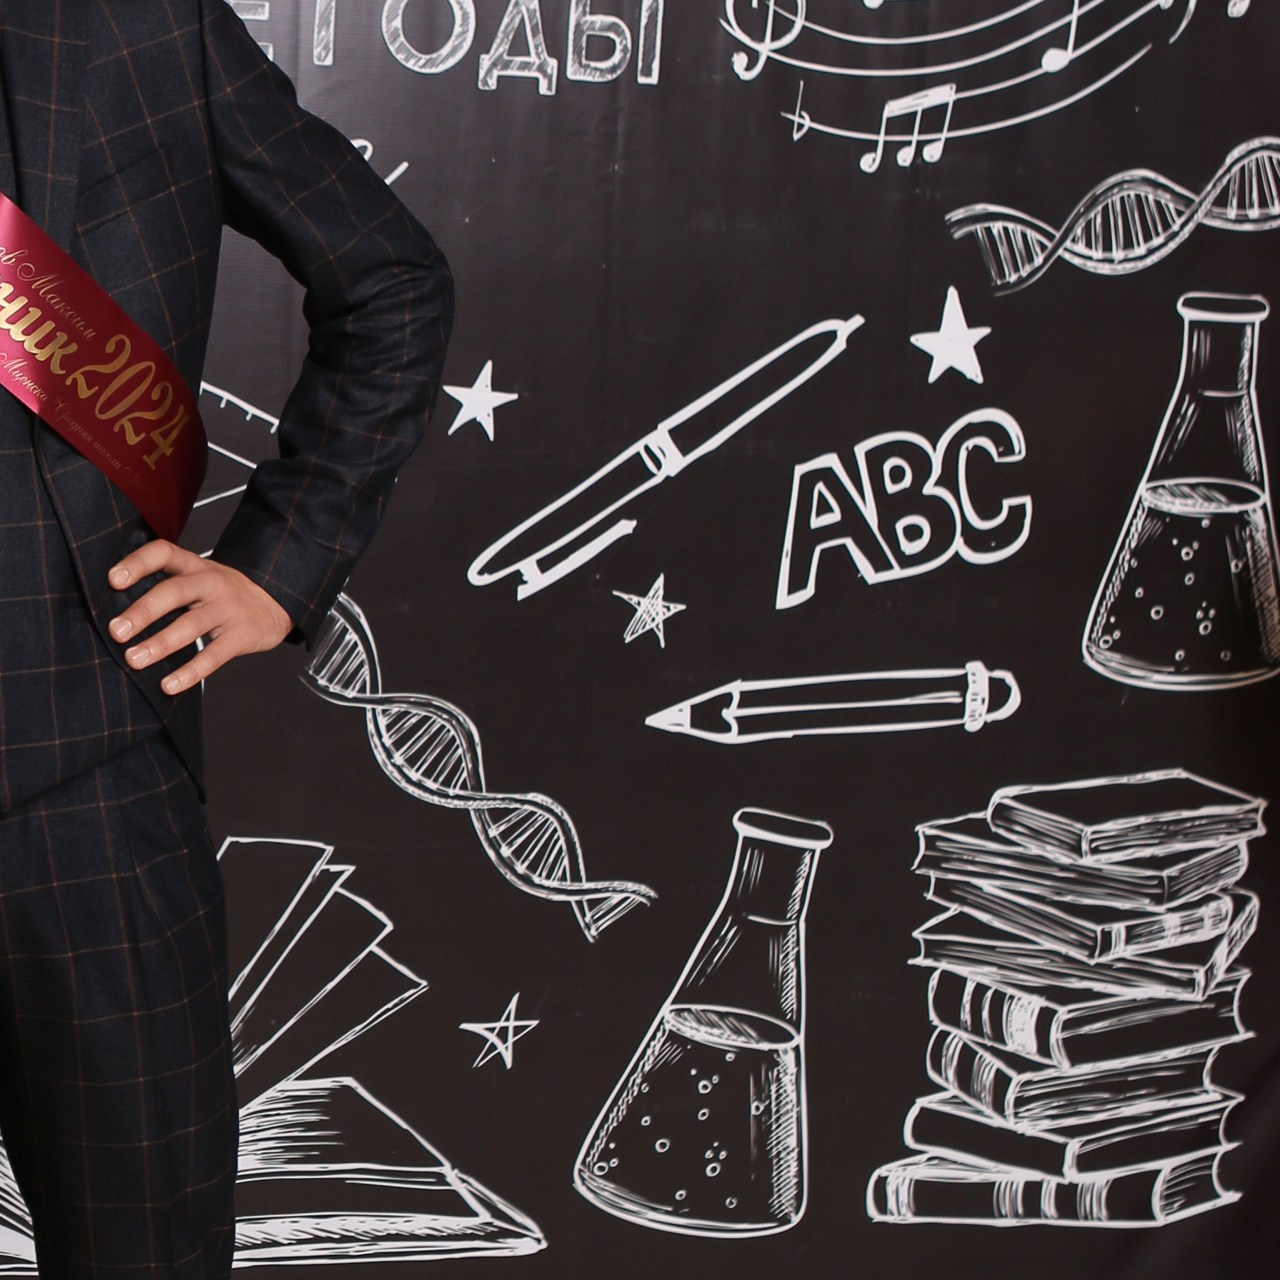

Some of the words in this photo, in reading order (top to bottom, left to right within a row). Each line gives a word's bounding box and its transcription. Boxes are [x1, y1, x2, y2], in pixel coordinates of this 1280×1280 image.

[17, 263, 97, 341] Максим
[66, 333, 190, 471] 2024
[775, 407, 1032, 610] ABC
